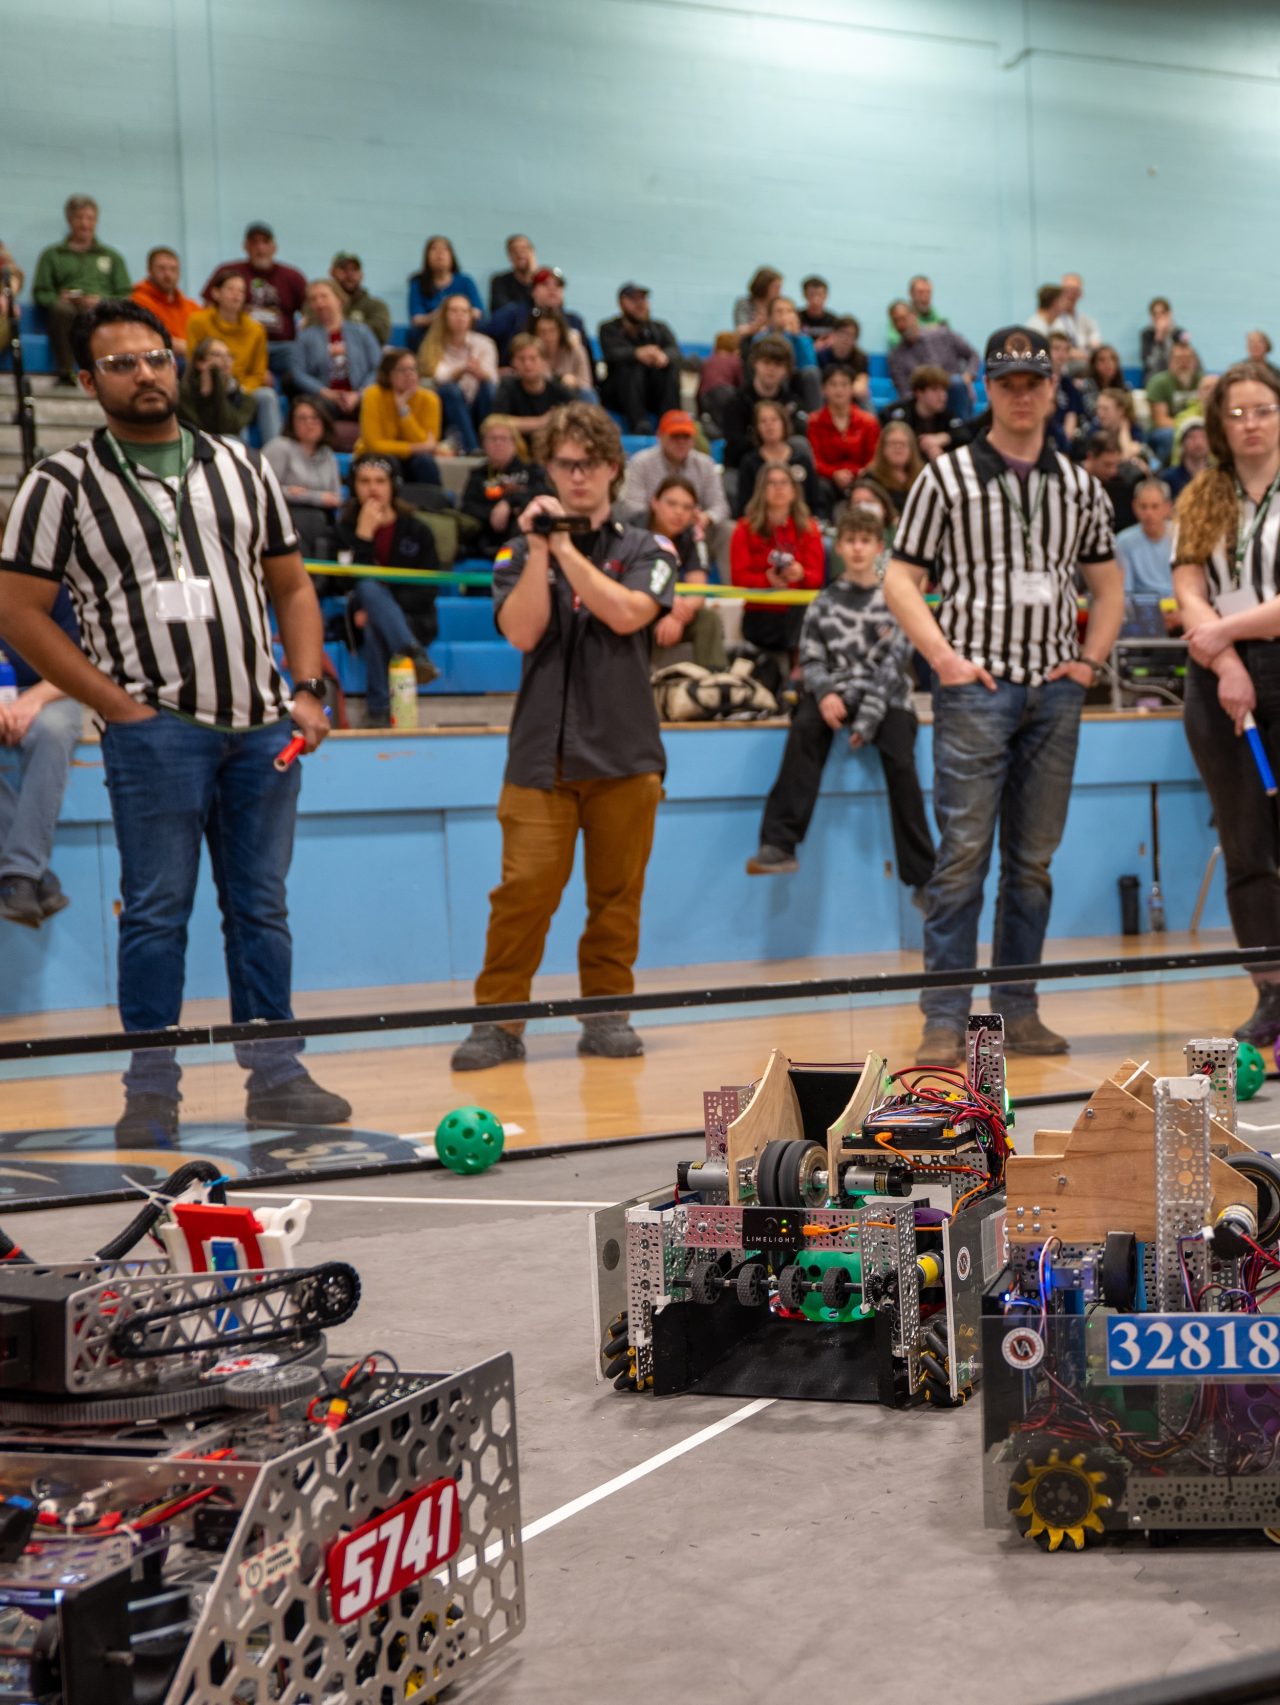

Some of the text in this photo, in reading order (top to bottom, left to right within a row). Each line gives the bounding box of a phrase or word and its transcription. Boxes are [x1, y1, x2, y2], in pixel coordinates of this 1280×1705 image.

[746, 1235, 796, 1243] LIMELIGHT
[1110, 1321, 1280, 1370] 32818
[339, 1485, 454, 1620] 5741
